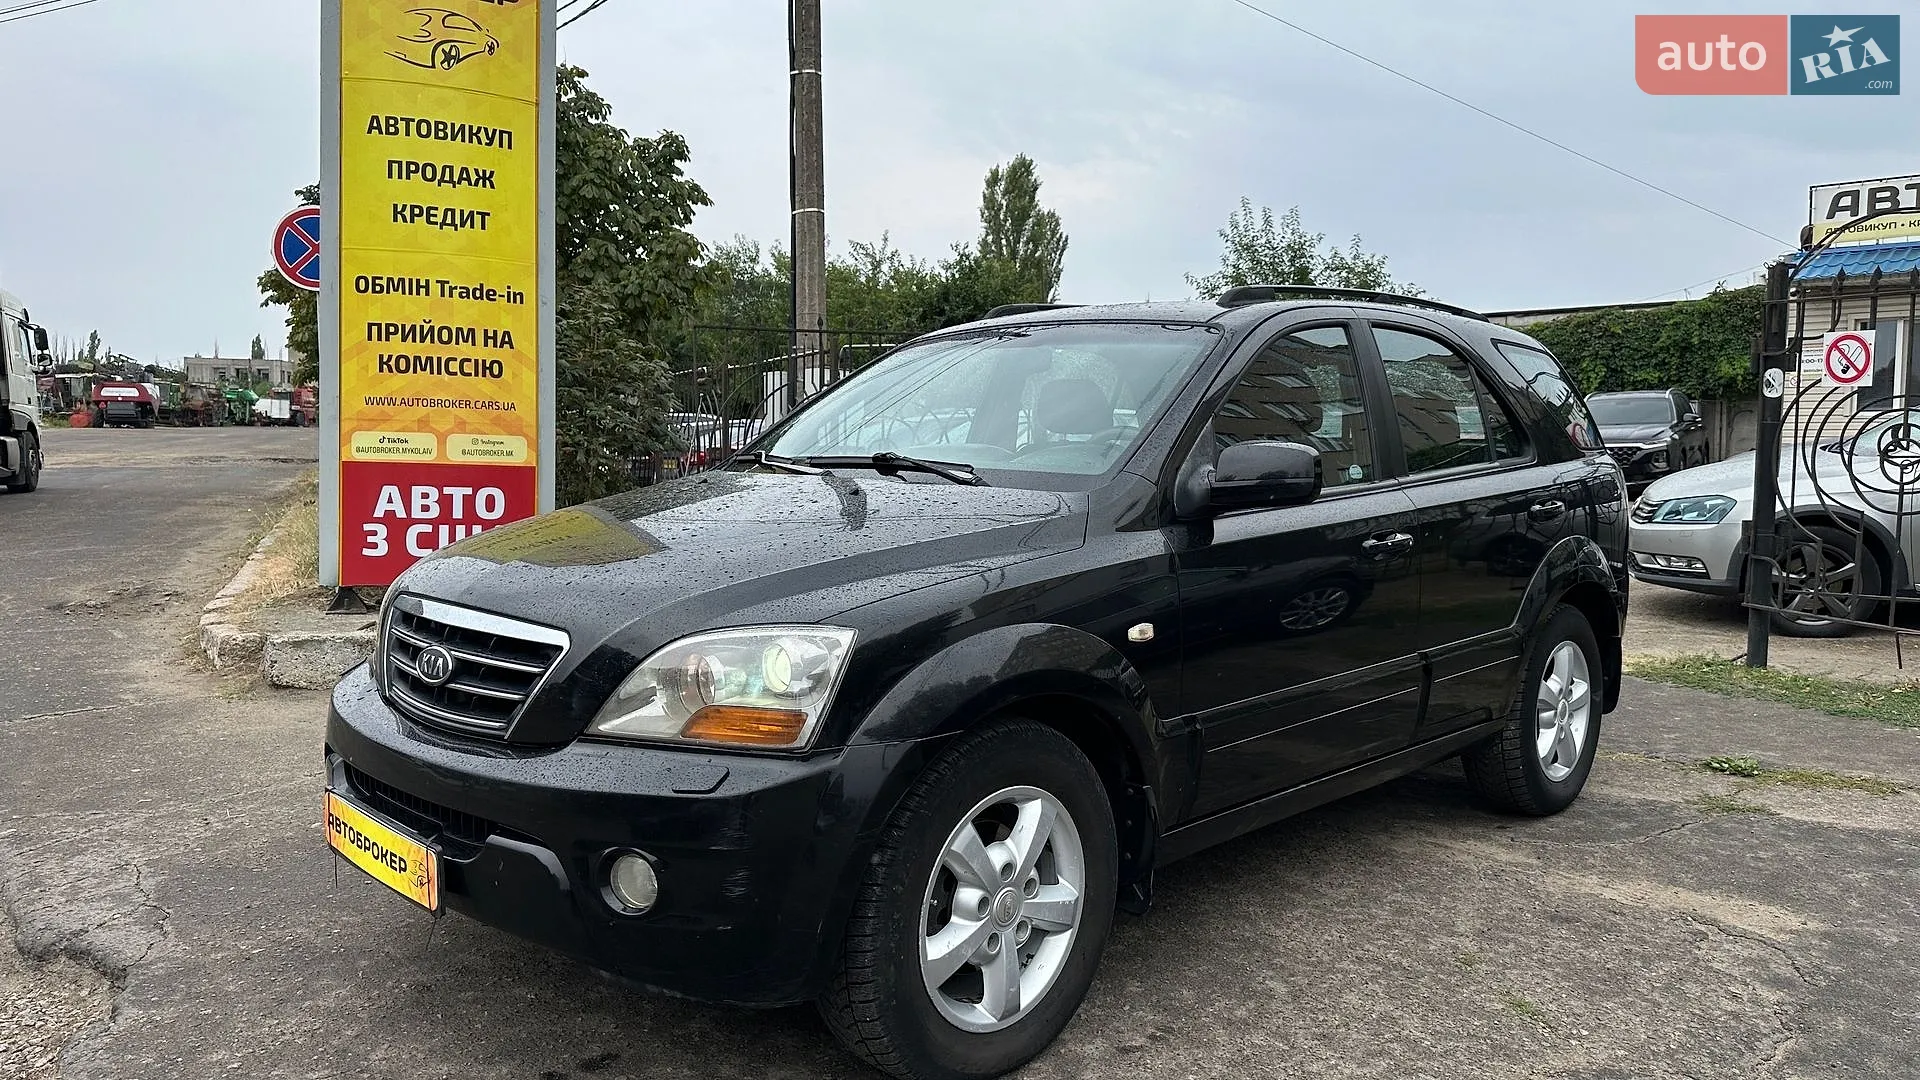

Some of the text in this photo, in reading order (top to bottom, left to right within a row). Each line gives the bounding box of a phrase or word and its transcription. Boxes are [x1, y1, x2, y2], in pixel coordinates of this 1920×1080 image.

[366, 114, 513, 150] АВТОВИКУП
[387, 159, 496, 189] ПРОДАЖ
[392, 203, 490, 231] КРЕДИТ
[354, 275, 525, 305] ОБМІН Trade-in
[366, 319, 515, 350] ПРИЙОМ НА
[377, 353, 504, 379] КОМІССІЮ
[364, 396, 517, 412] WWW.AUTOBROKER.CARS.UA
[386, 437, 409, 445] TikTok
[480, 438, 505, 447] Instagram
[372, 485, 506, 520] АВТО
[421, 652, 444, 678] KIA
[328, 812, 408, 874] АВТОБРОКЕР
